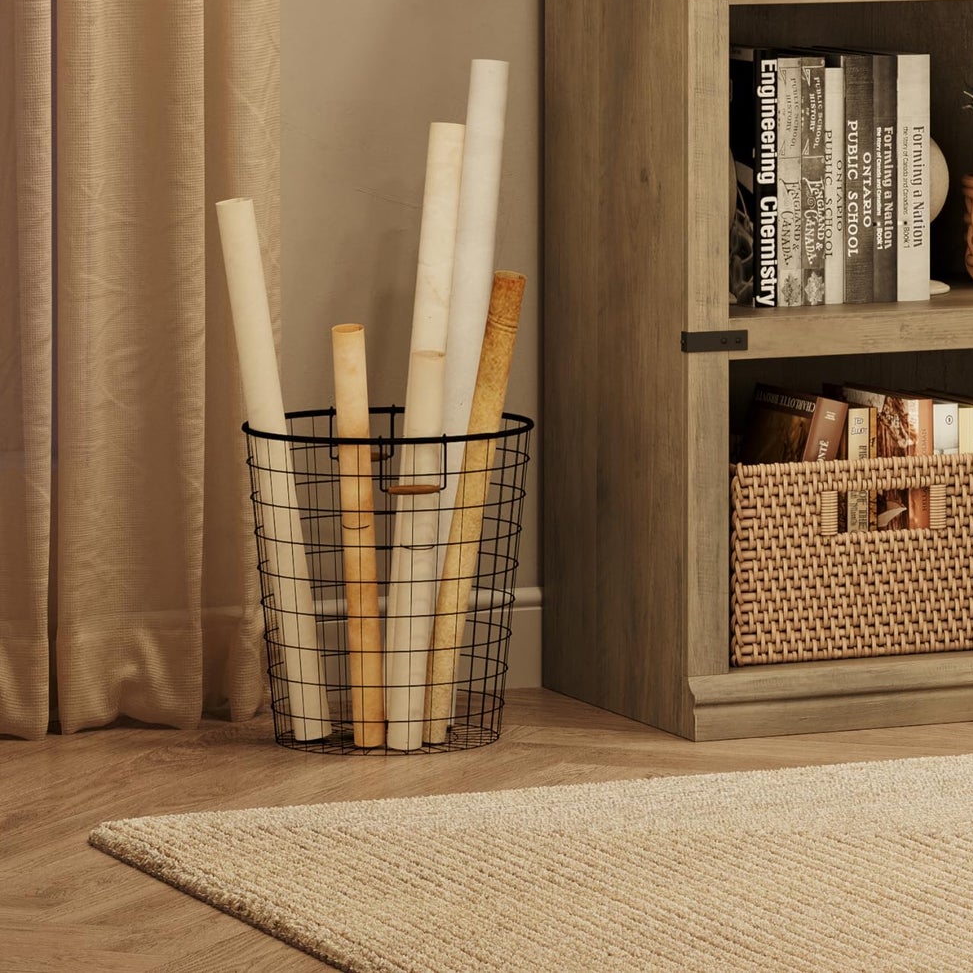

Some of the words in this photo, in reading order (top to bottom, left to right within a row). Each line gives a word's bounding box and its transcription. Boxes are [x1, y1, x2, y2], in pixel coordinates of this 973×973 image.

[756, 58, 778, 185] Engineering
[813, 77, 823, 109] PUBLIC
[813, 113, 823, 149] SCHOOL
[824, 130, 833, 186] PUBLIC
[847, 120, 859, 180] PUBLIC
[882, 126, 894, 187] Forming
[911, 126, 925, 185] Forming
[862, 152, 872, 228] ONTARIO
[884, 190, 893, 199] a
[913, 190, 923, 198] a
[755, 196, 778, 307] Chemistry
[824, 197, 833, 259] SCHOOL
[847, 190, 859, 257] SCHOOL
[884, 201, 894, 250] Nation
[913, 201, 925, 248] Nation
